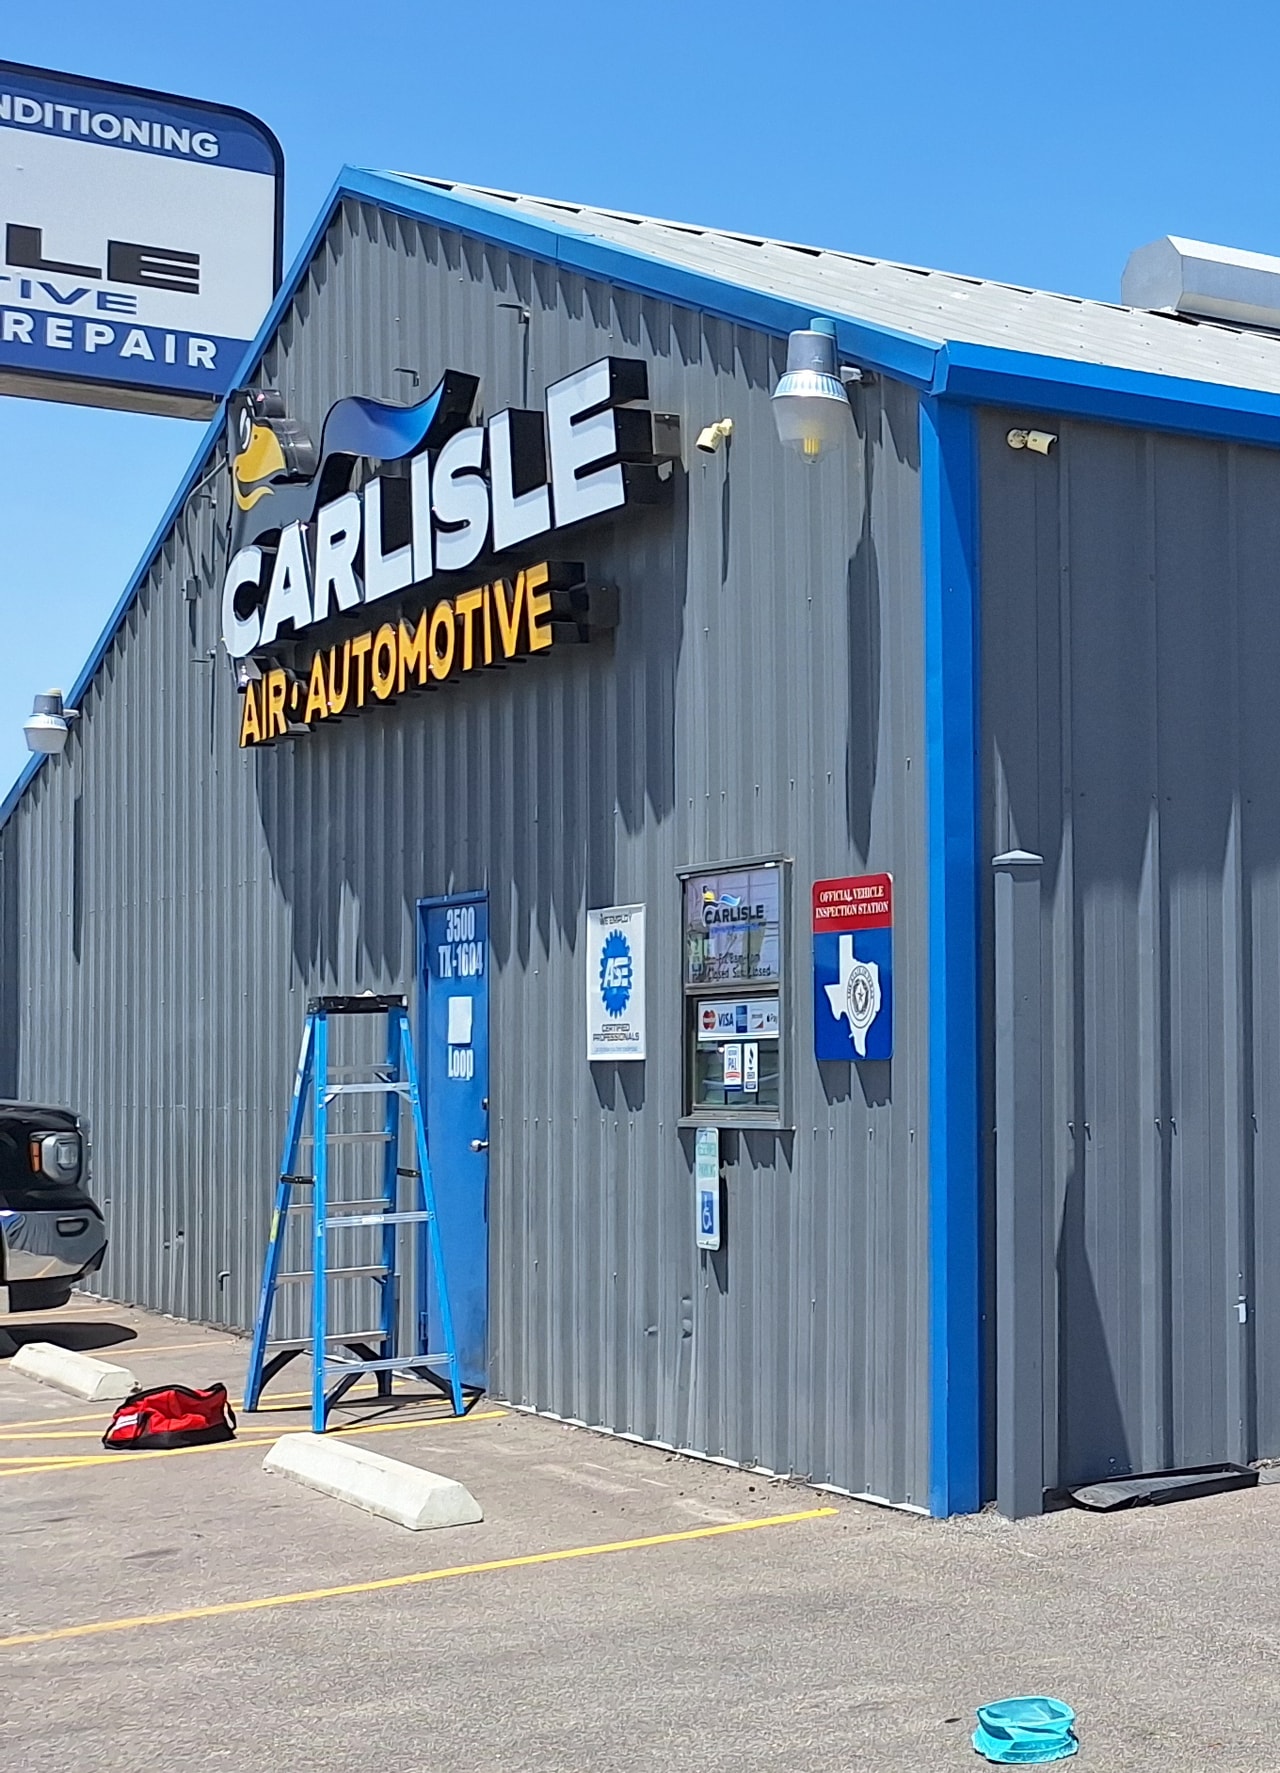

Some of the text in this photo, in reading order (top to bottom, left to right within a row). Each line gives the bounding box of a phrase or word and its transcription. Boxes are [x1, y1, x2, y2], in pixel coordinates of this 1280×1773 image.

[3, 309, 217, 370] REPAIR
[222, 357, 625, 659] CARLISLE
[240, 561, 553, 748] AIR AUTOMOTIVE
[815, 901, 889, 919] INSPECTION STATION
[819, 885, 884, 903] OFFICIAL VEHICLE
[446, 906, 475, 943] 3500
[704, 904, 764, 924] CARLISLE
[438, 941, 484, 978] TX-1604
[602, 956, 629, 988] ASE
[718, 1012, 735, 1027] VISA
[448, 1044, 474, 1080] Loop
